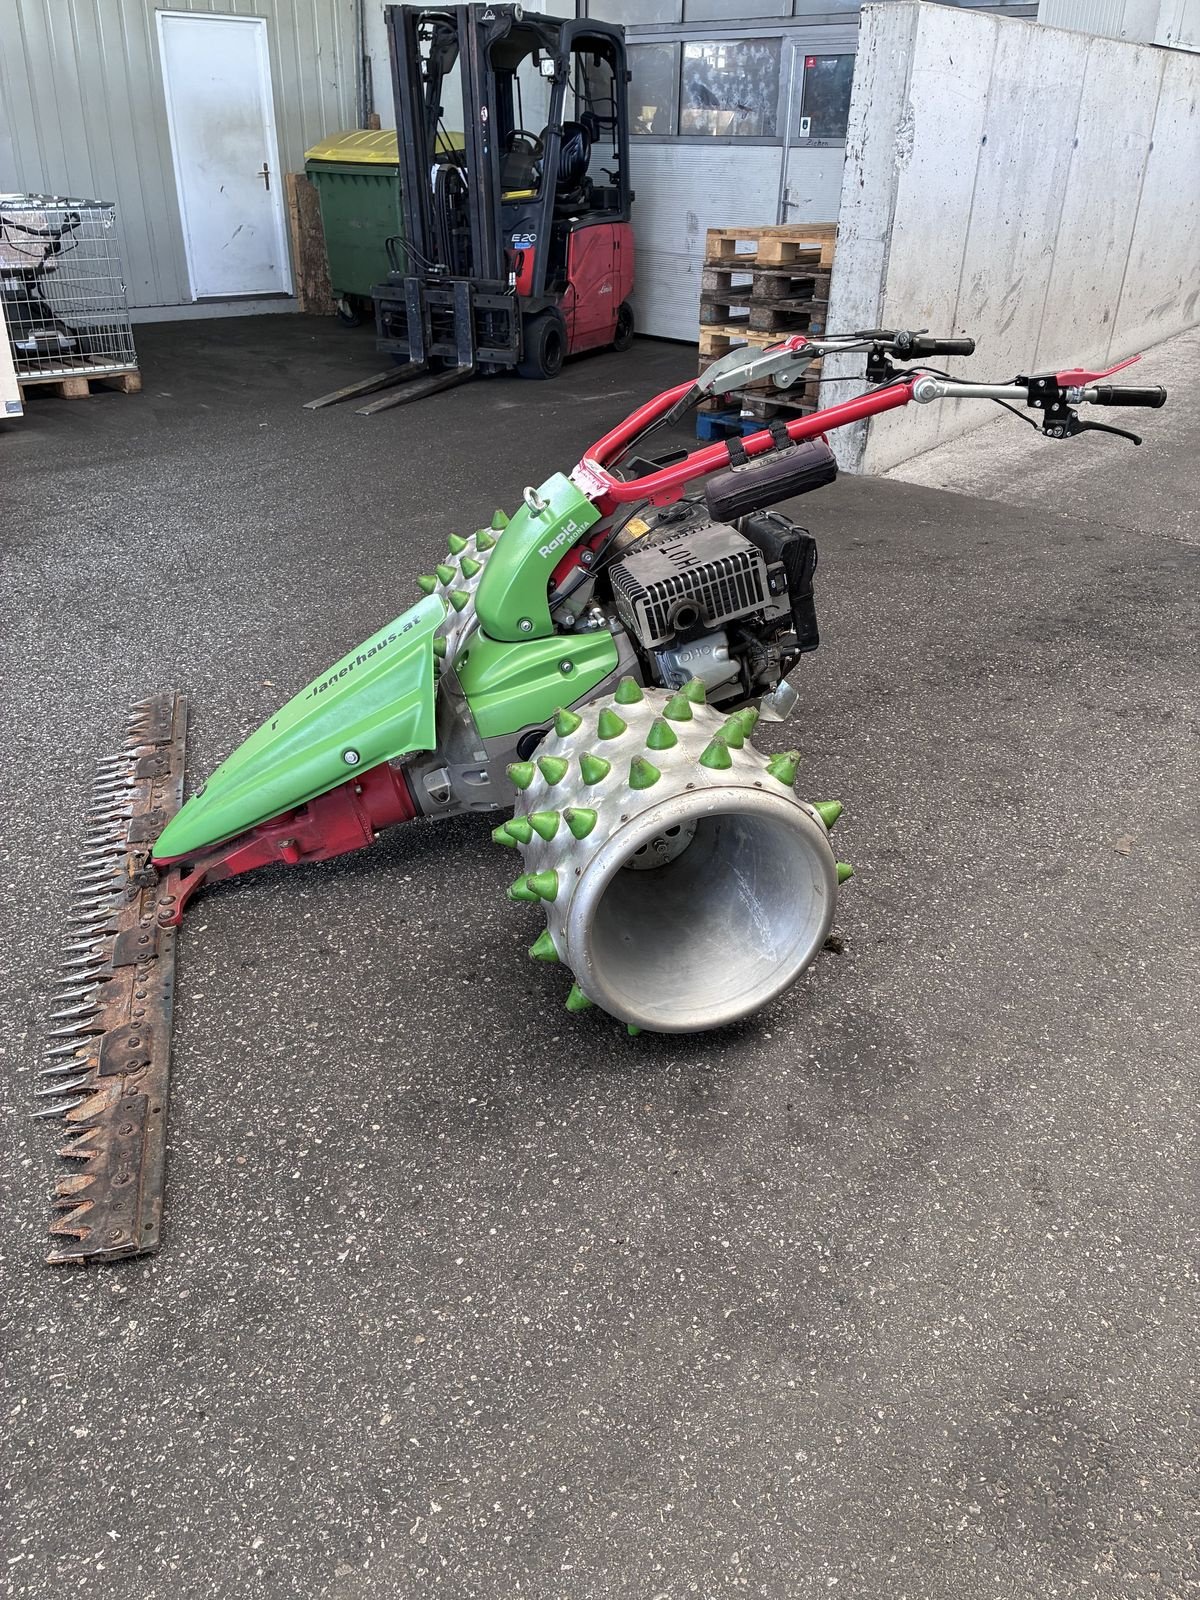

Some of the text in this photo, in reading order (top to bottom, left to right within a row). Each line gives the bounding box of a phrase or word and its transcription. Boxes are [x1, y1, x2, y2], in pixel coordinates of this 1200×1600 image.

[538, 519, 578, 559] Rapid
[567, 521, 590, 544] MONTA
[658, 543, 702, 571] HOT
